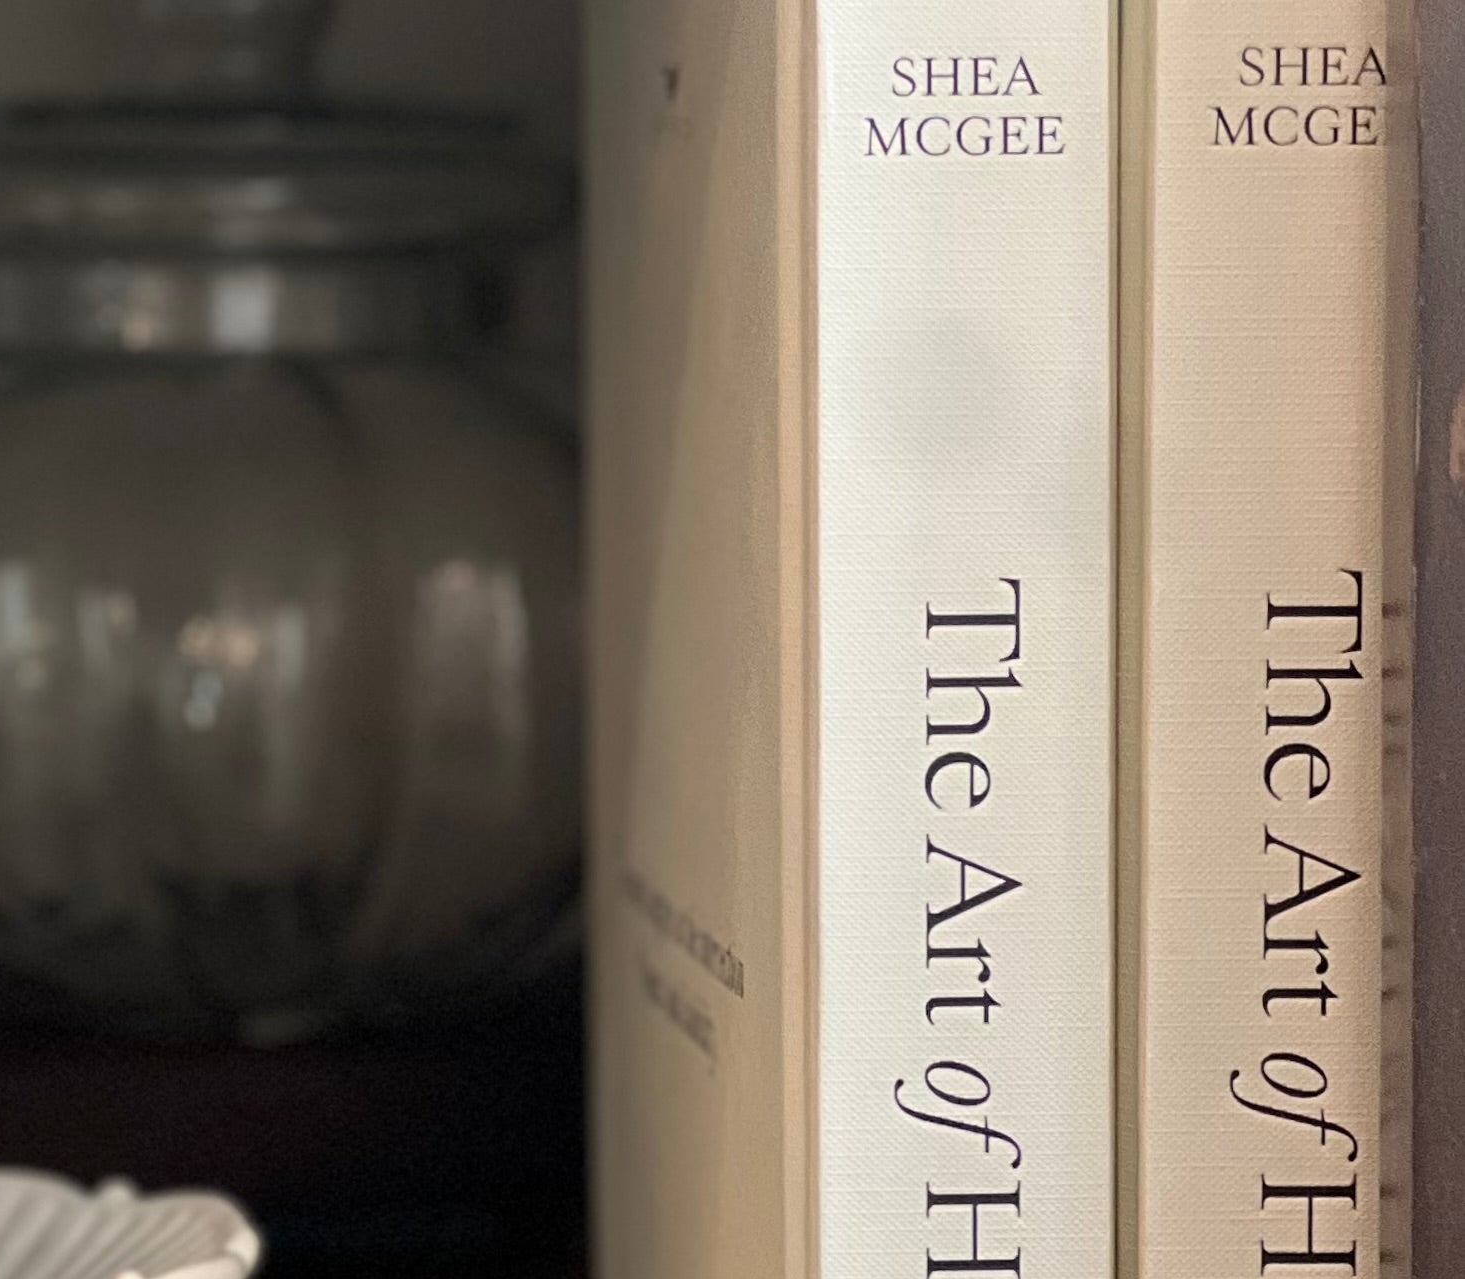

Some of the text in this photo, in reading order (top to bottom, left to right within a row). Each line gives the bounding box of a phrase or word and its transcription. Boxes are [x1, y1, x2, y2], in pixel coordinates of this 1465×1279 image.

[892, 56, 1040, 97] SHEA
[1240, 46, 1388, 87] SHEA
[867, 116, 1064, 156] MCGEE
[1214, 105, 1388, 146] MCGE
[924, 577, 1023, 809] The
[1263, 568, 1364, 801] The
[925, 834, 1023, 1025] Art
[1261, 824, 1362, 1017] Art
[894, 1060, 1022, 1170] of
[1229, 1052, 1359, 1163] of
